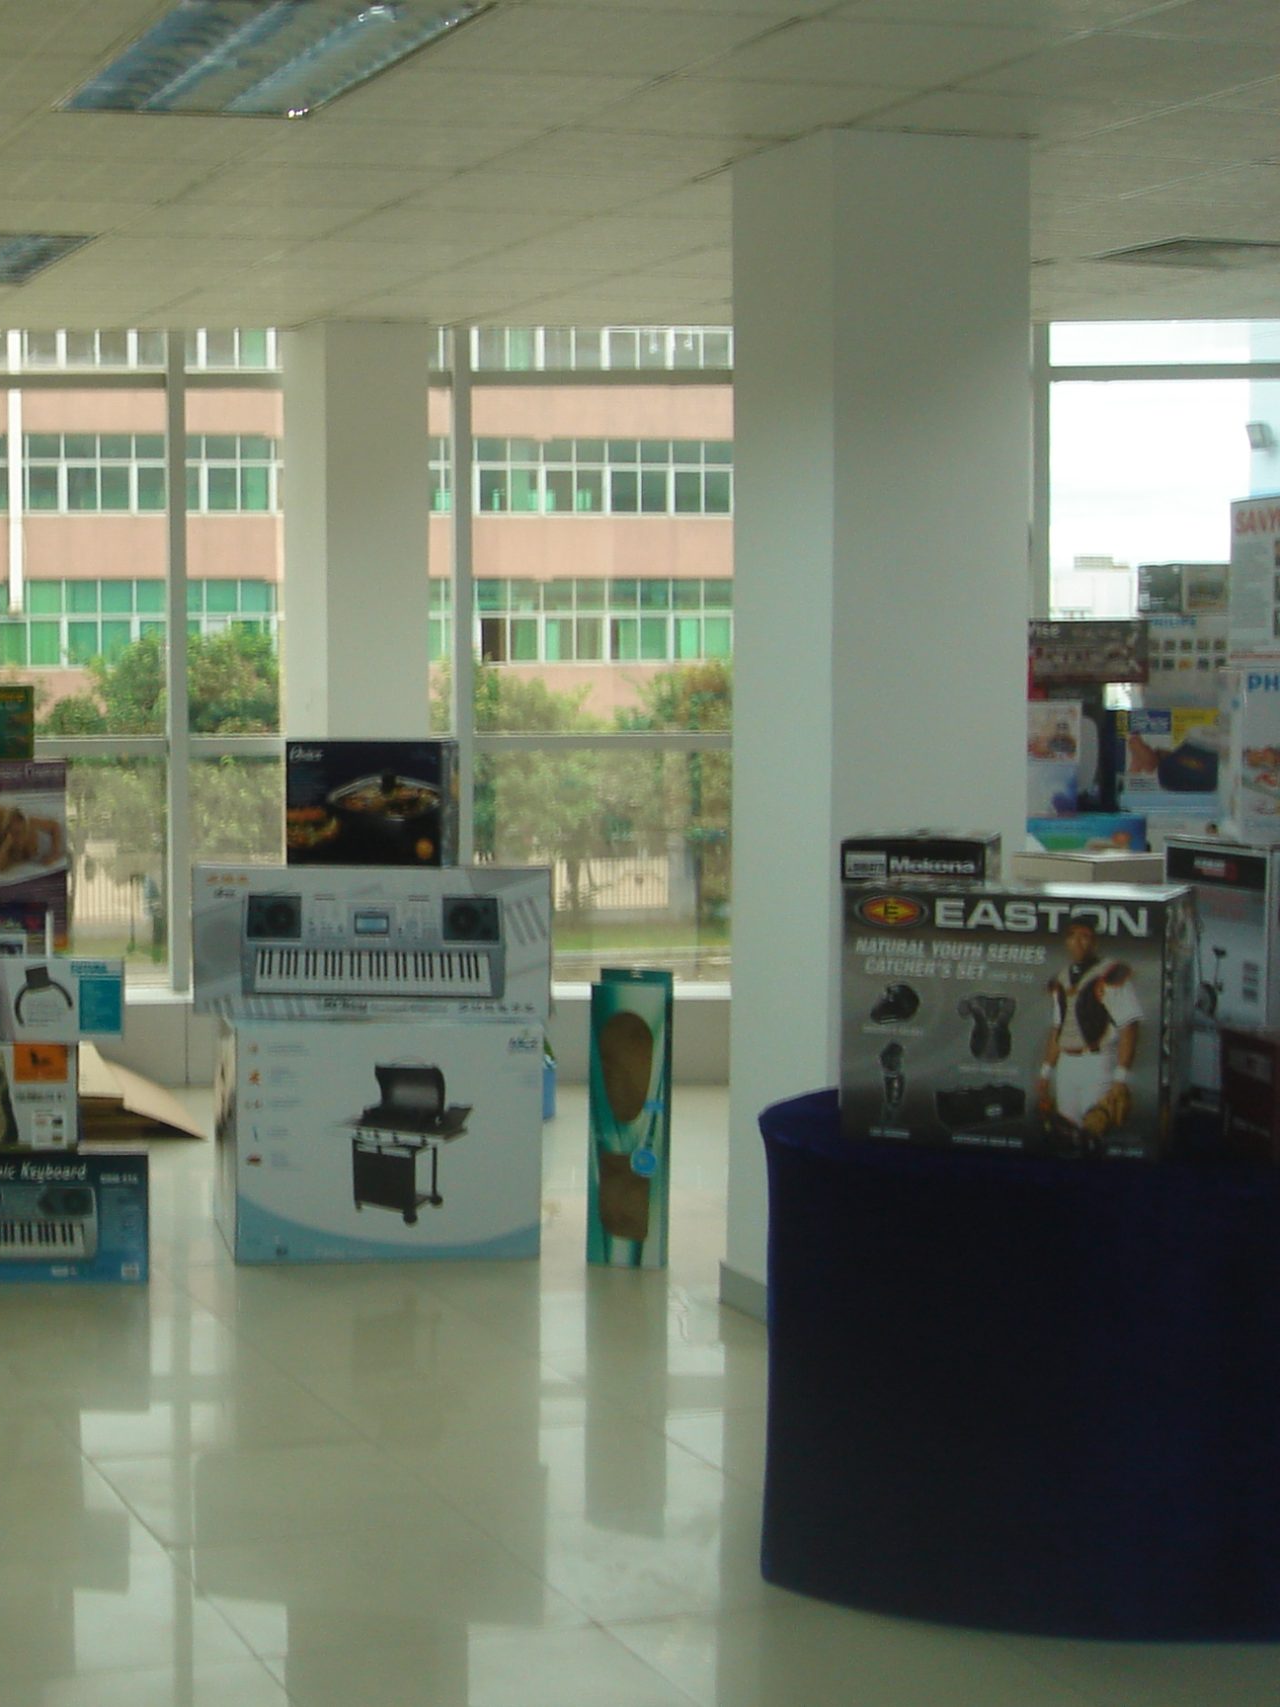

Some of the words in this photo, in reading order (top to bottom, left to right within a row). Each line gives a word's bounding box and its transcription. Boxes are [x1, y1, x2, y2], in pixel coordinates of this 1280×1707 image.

[934, 897, 1150, 937] EASTON
[856, 937, 926, 958] NATURAL
[931, 941, 984, 960] YOUTH
[987, 944, 1047, 965] SERIES
[20, 1160, 88, 1184] Keyboard
